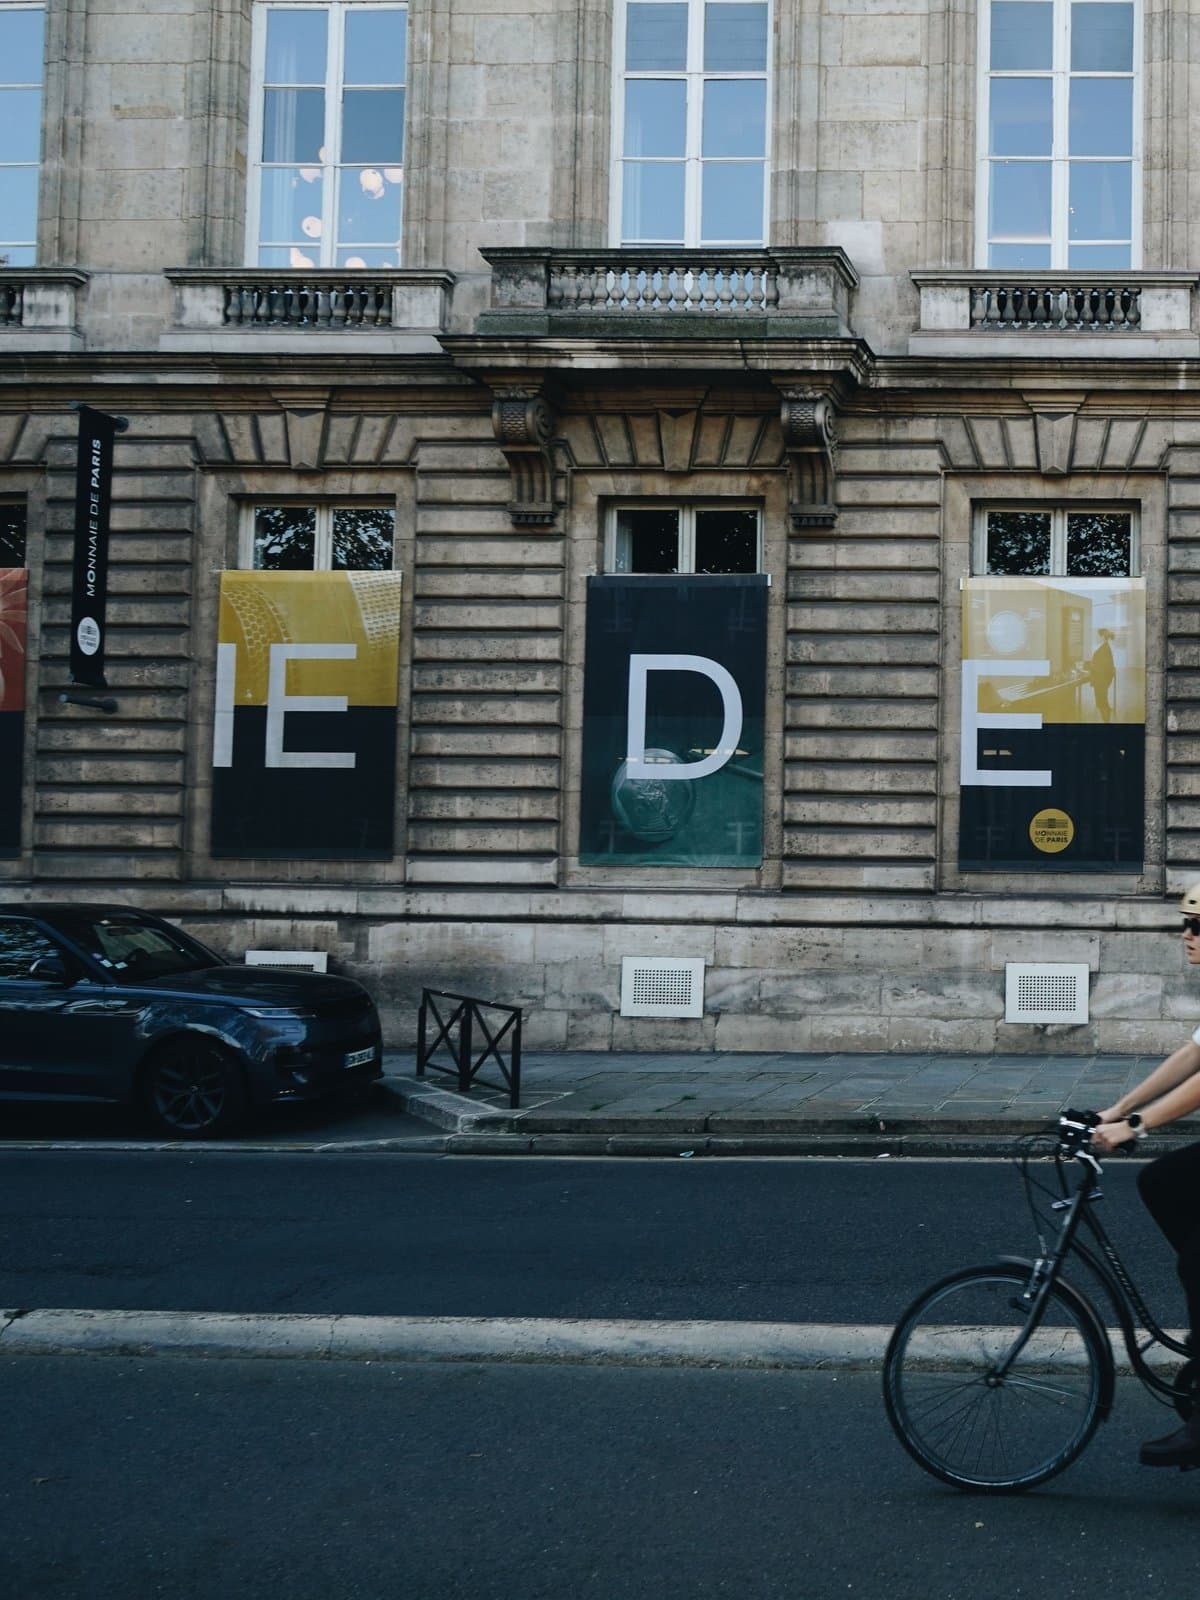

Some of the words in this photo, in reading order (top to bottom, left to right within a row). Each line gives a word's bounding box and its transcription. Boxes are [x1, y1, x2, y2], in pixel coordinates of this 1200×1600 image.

[91, 439, 101, 488] PARIS
[90, 492, 99, 516] DE
[87, 520, 98, 597] MONNAIE
